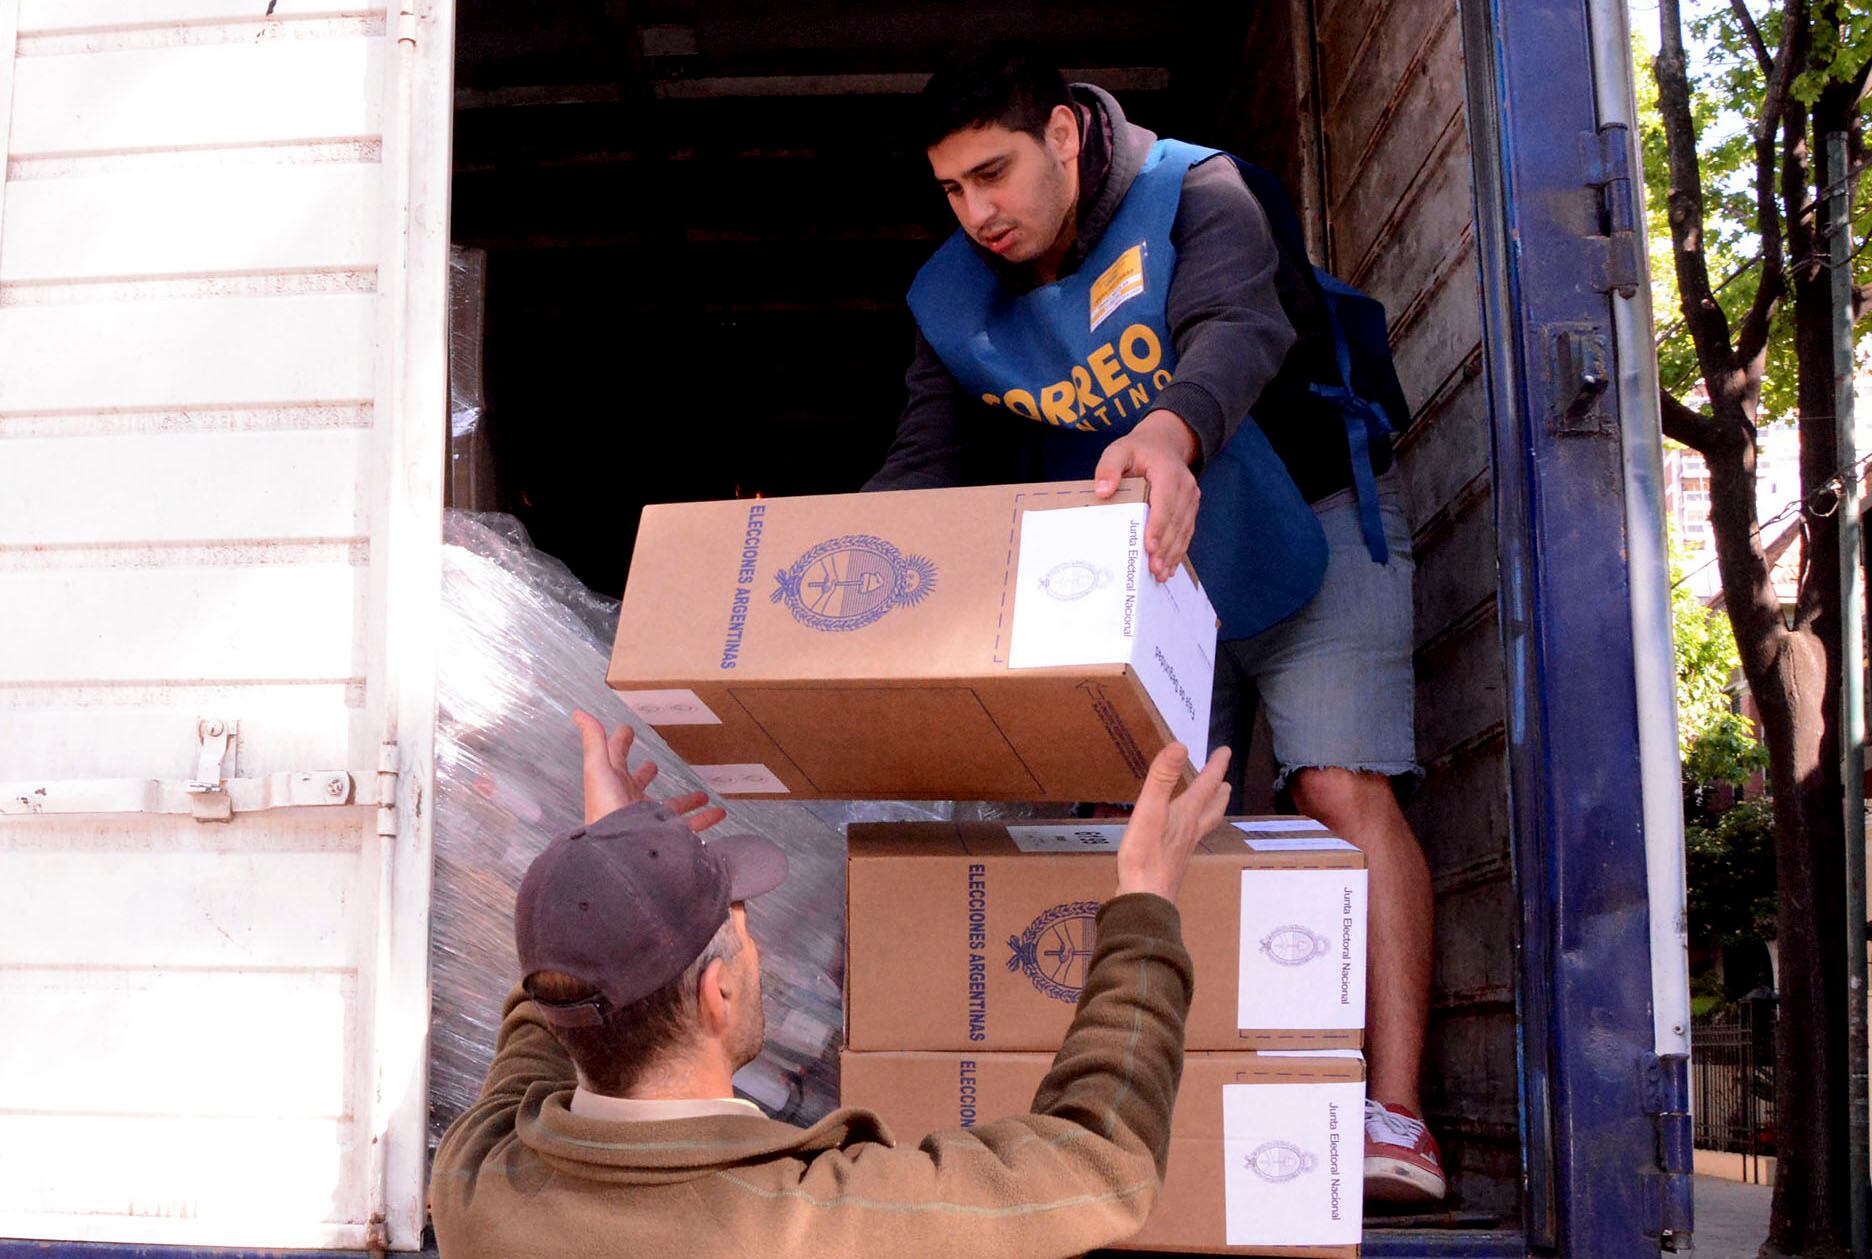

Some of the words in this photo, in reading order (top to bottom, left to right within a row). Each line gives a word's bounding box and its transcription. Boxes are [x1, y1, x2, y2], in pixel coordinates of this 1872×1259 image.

[982, 323, 1162, 426] ORREO
[738, 505, 766, 584] ELECCIONES
[1129, 519, 1140, 547] Junta
[1126, 549, 1139, 592] Electoral
[720, 588, 750, 670] ARGENTINAS
[1123, 594, 1136, 637] Nacional
[968, 863, 986, 950] ELECCIONES
[1343, 886, 1353, 915] Junta
[1342, 918, 1353, 960] Electoral
[968, 953, 986, 1041] ARGENTINAS
[1340, 962, 1351, 1005] Nacional
[960, 1061, 976, 1129] ELECCION
[1329, 1102, 1339, 1130] Junta
[1329, 1133, 1340, 1176] Electoral
[1330, 1178, 1341, 1221] Nacional
